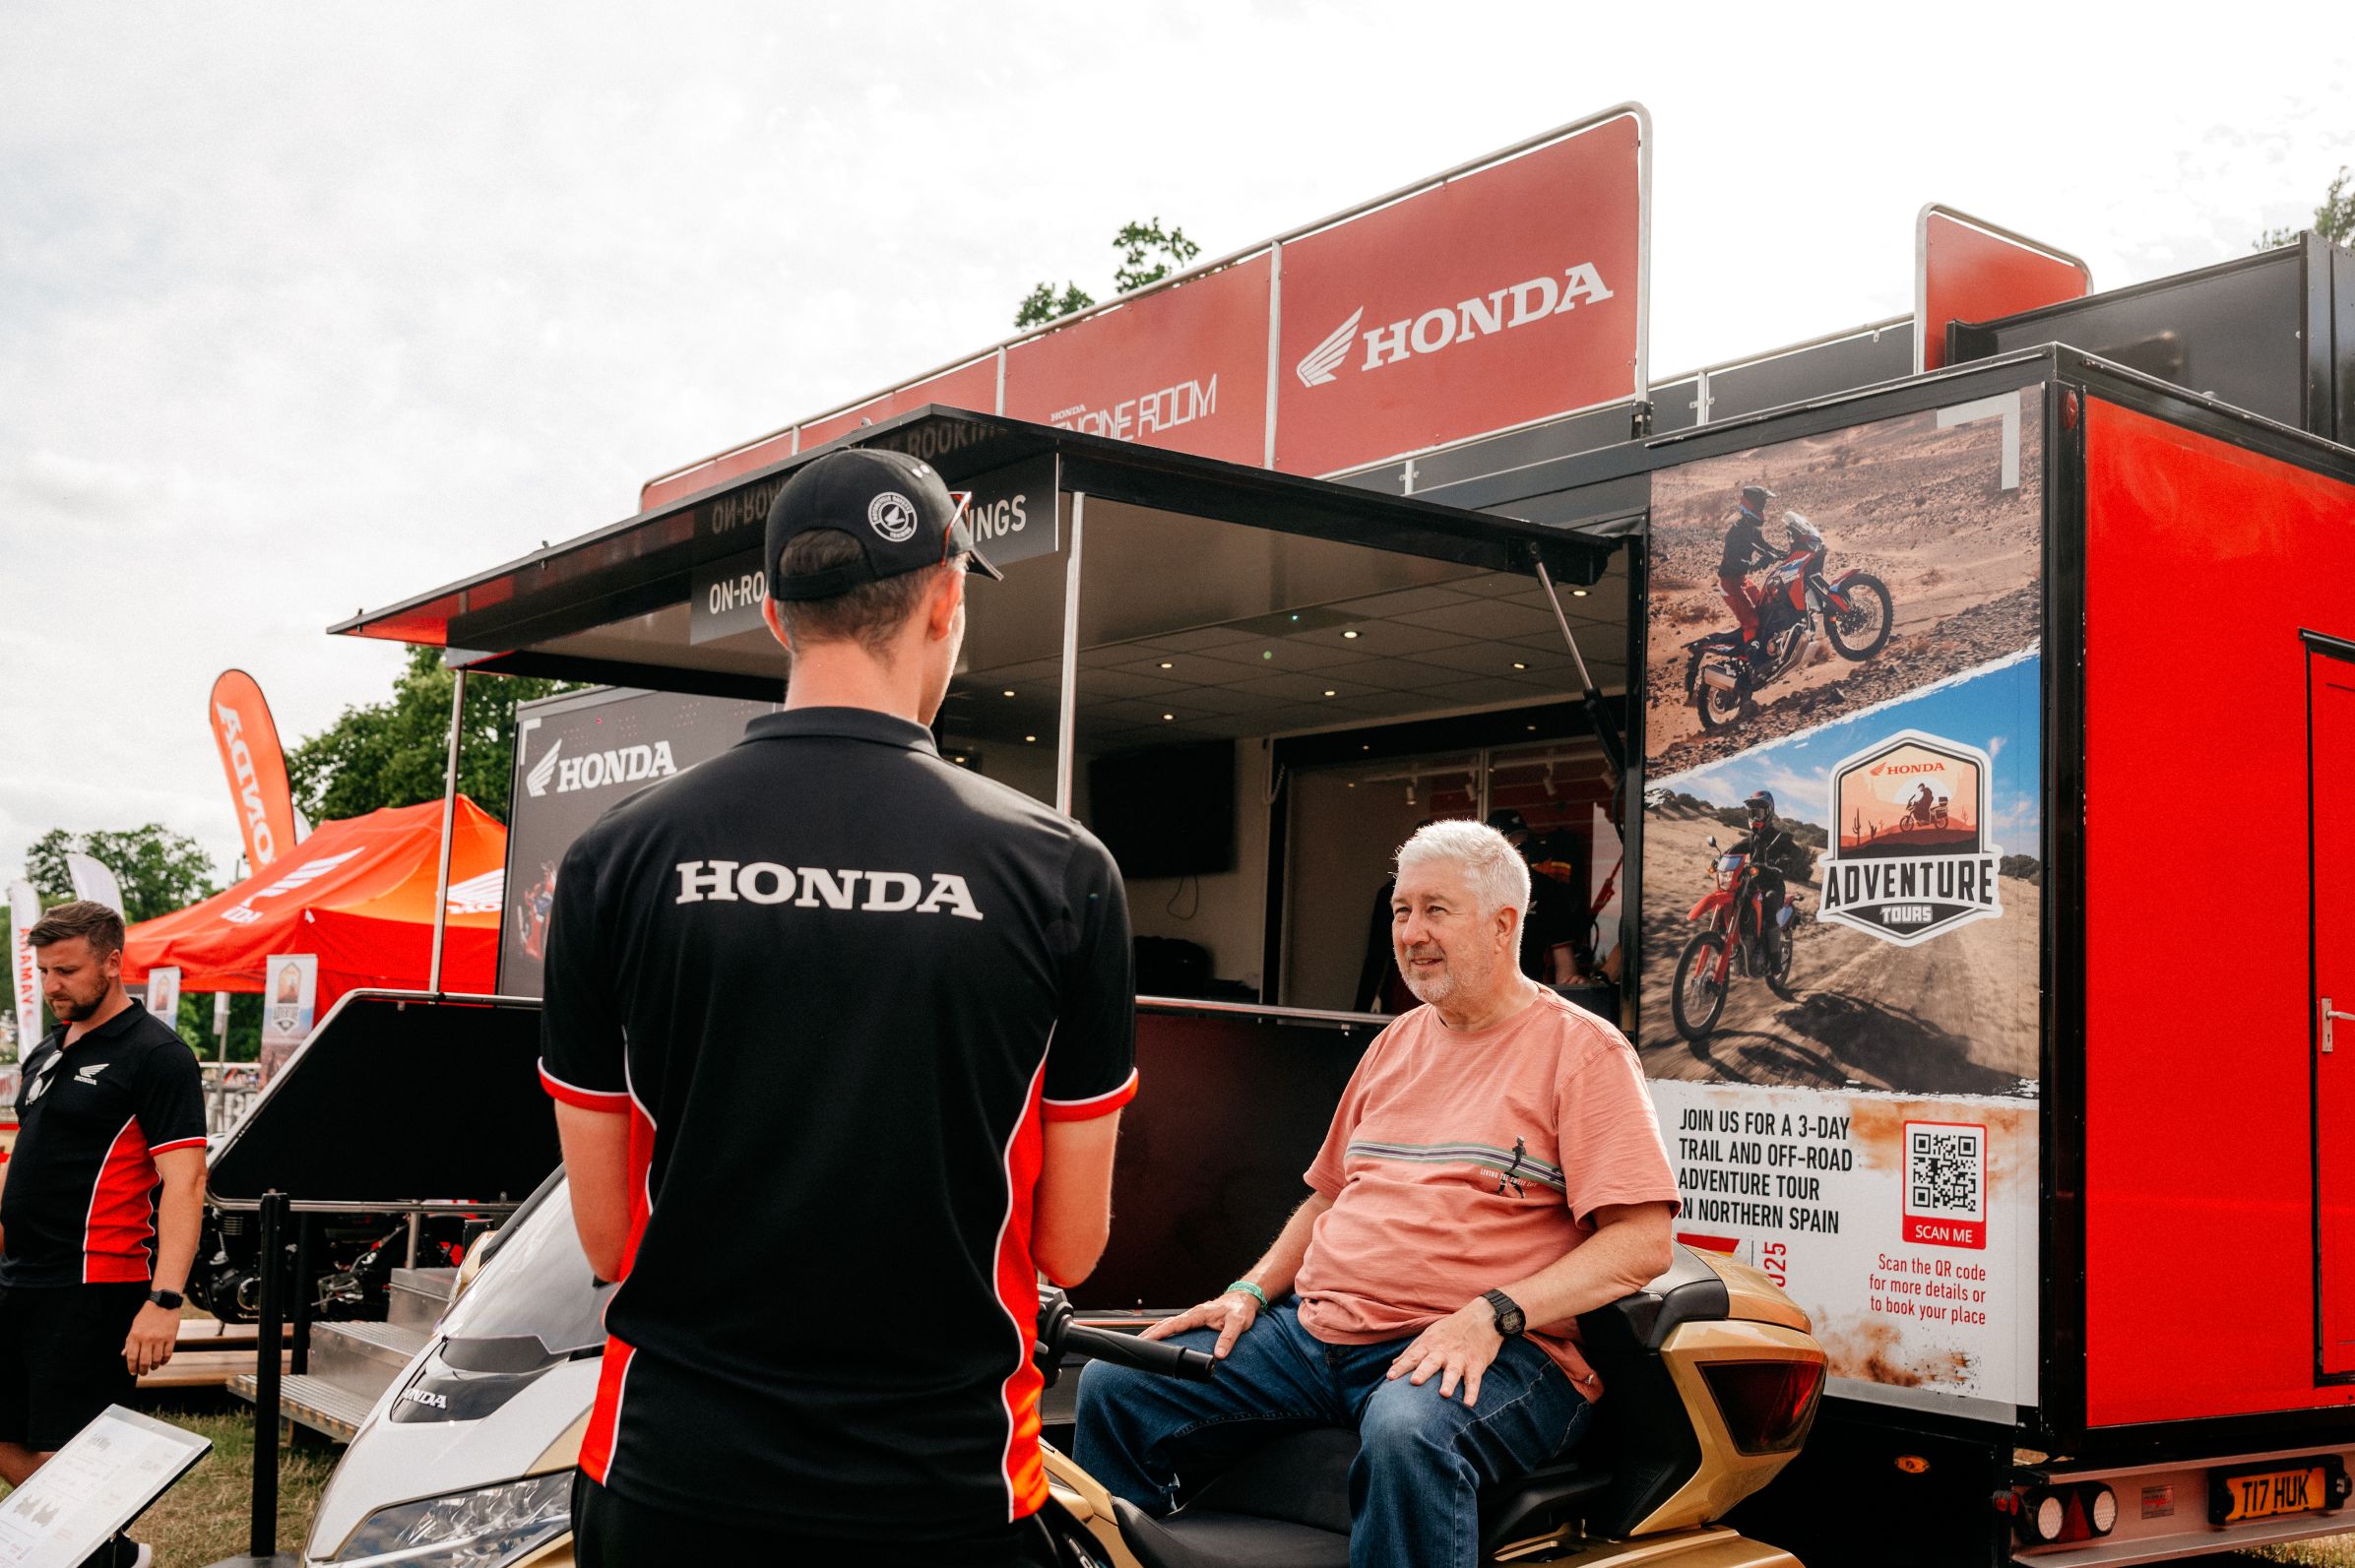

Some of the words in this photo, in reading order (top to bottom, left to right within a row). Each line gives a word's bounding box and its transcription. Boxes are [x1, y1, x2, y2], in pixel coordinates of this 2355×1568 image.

[1362, 262, 1614, 372] HONDA
[1050, 404, 1086, 421] HONDA
[1052, 400, 1136, 442] GINE
[1138, 373, 1217, 438] ROOM
[709, 571, 768, 615] ON-RO
[969, 494, 1027, 544] INGS
[557, 740, 677, 792] HONDA
[1886, 763, 1945, 775] HONDA
[675, 859, 984, 920] HONDA
[1825, 859, 1993, 909] ADVENTURE
[1880, 905, 1933, 924] TOURS
[1680, 1108, 1713, 1132] JOIN
[1719, 1110, 1740, 1133] US
[1745, 1112, 1775, 1135] FOR
[1781, 1113, 1792, 1137] A
[1799, 1114, 1850, 1140] 3-DAY
[1679, 1138, 1723, 1162] TRAIL
[1729, 1141, 1762, 1164] AND
[1768, 1144, 1853, 1171] OFF-ROAD
[1679, 1167, 1770, 1196] ADVENTURE
[1776, 1174, 1819, 1201] TOUR
[1698, 1198, 1783, 1228] NORTHERN
[1789, 1207, 1839, 1234] SPAIN
[1915, 1224, 1948, 1241] SCAN
[1953, 1228, 1972, 1243] ME
[1878, 1253, 1907, 1272] Scan
[1912, 1257, 1931, 1275] the
[1936, 1260, 1951, 1278] QR
[1956, 1264, 1986, 1281] code
[1870, 1274, 1886, 1290] for
[1890, 1281, 1921, 1295] more
[1926, 1281, 1968, 1300] details
[1973, 1289, 1986, 1302] or
[1871, 1295, 1881, 1311] to
[1886, 1296, 1915, 1315] book
[1920, 1304, 1947, 1321] your
[1951, 1305, 1986, 1325] place
[2242, 1479, 2269, 1513] T17
[2274, 1474, 2309, 1509] HUK
